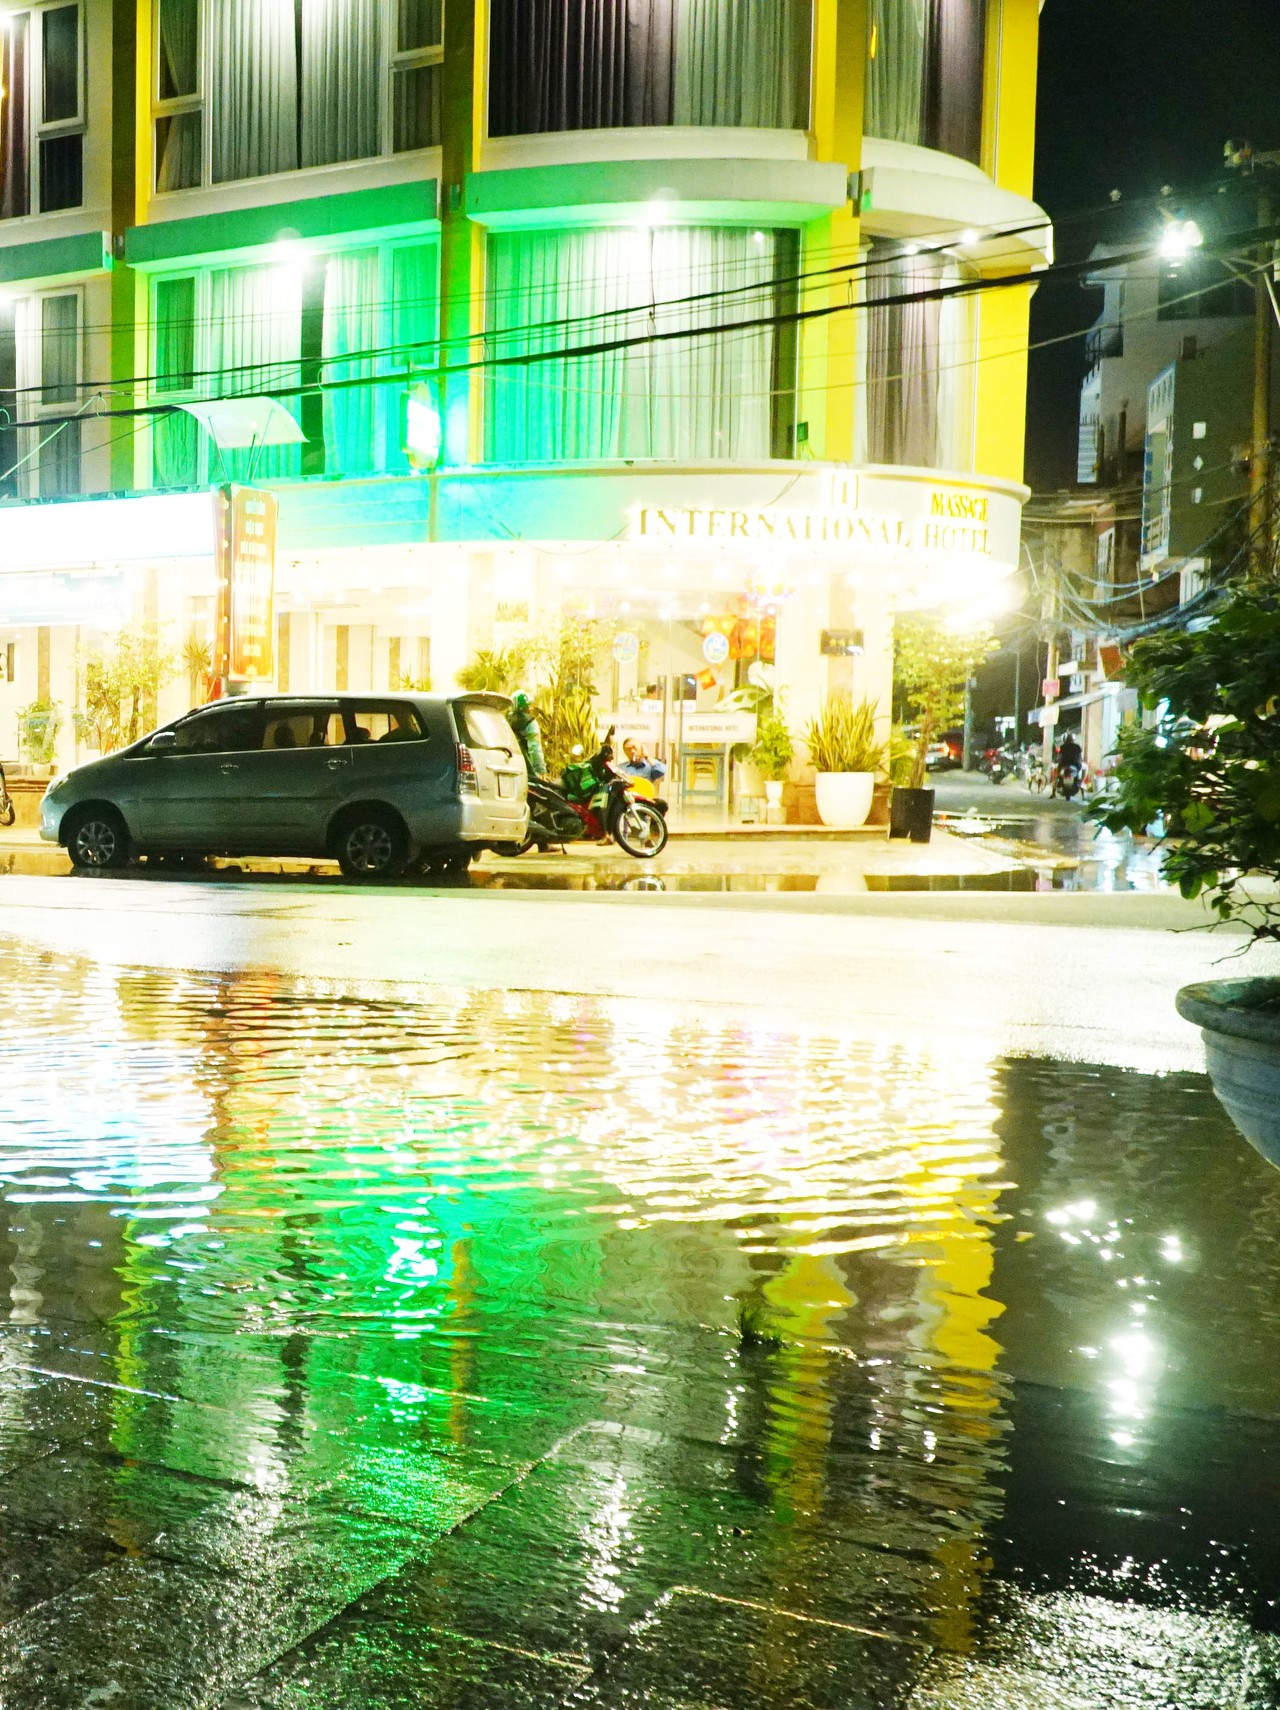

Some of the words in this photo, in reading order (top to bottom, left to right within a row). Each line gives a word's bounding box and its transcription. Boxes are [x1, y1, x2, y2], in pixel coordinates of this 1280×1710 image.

[930, 491, 990, 523] MASSAGE
[639, 508, 913, 549] INTERNATIONAL
[922, 522, 993, 556] HOTEL
